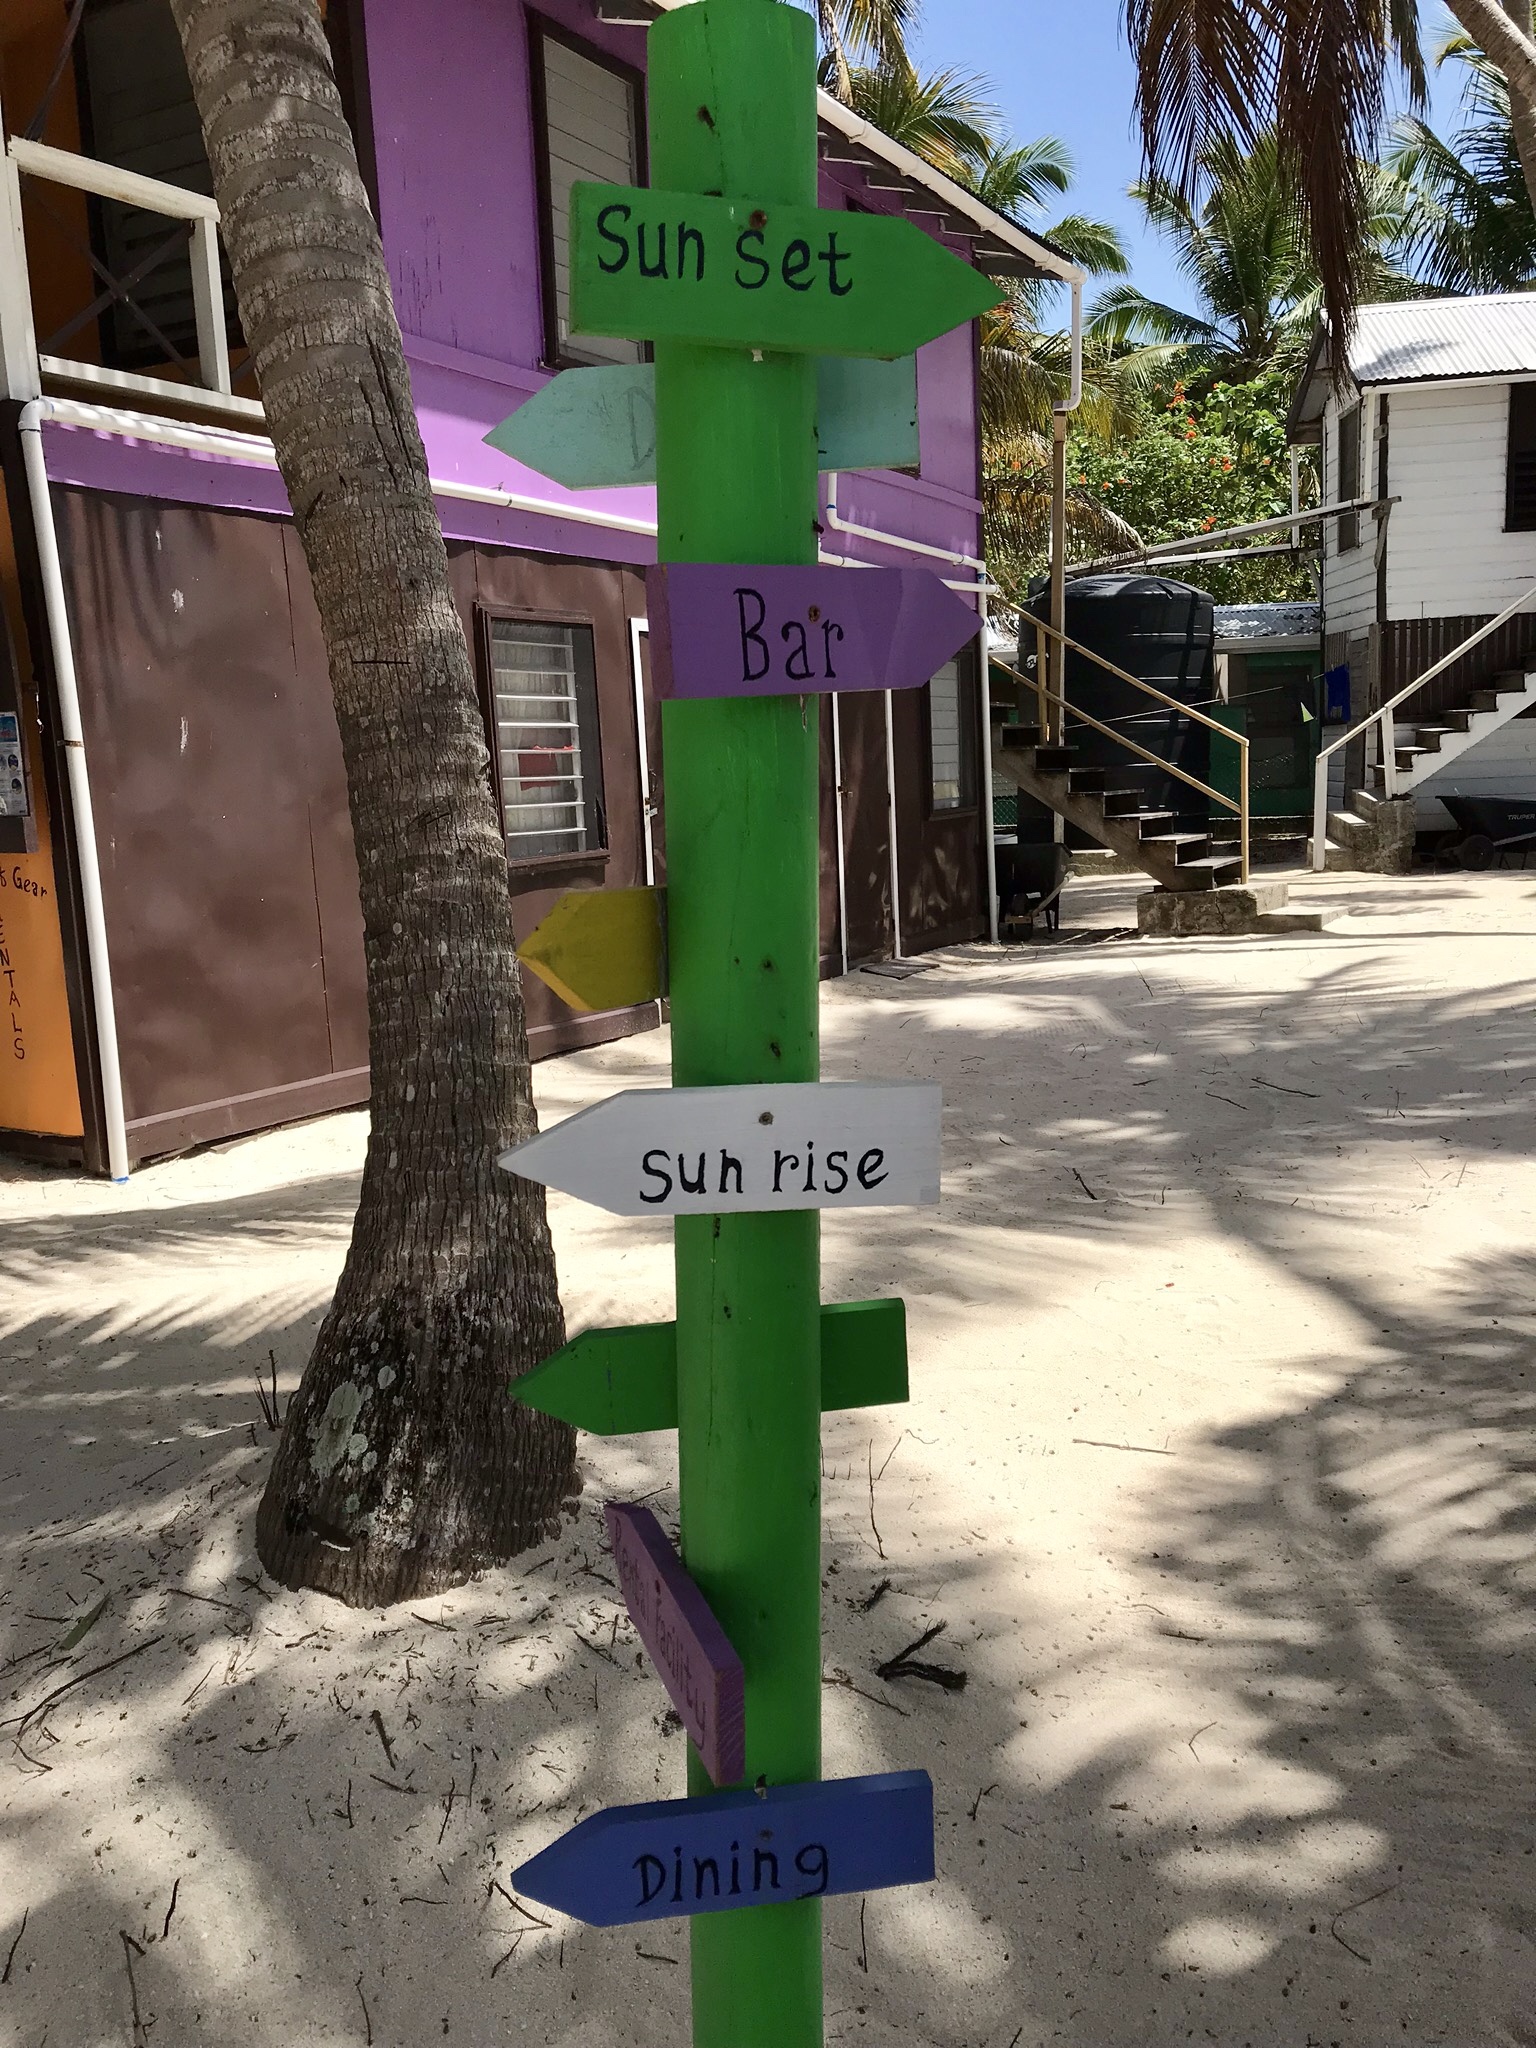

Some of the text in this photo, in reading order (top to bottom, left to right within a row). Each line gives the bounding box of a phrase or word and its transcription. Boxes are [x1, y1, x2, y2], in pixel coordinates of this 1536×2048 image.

[597, 204, 705, 282] Sun
[733, 588, 844, 681] Bar
[1507, 813, 1536, 821] TRUPER
[13, 866, 47, 897] Gear
[0, 915, 25, 1060] NTALS
[772, 1141, 889, 1194] rise
[615, 1515, 650, 1627] Rental
[632, 1840, 829, 1908] Dining
